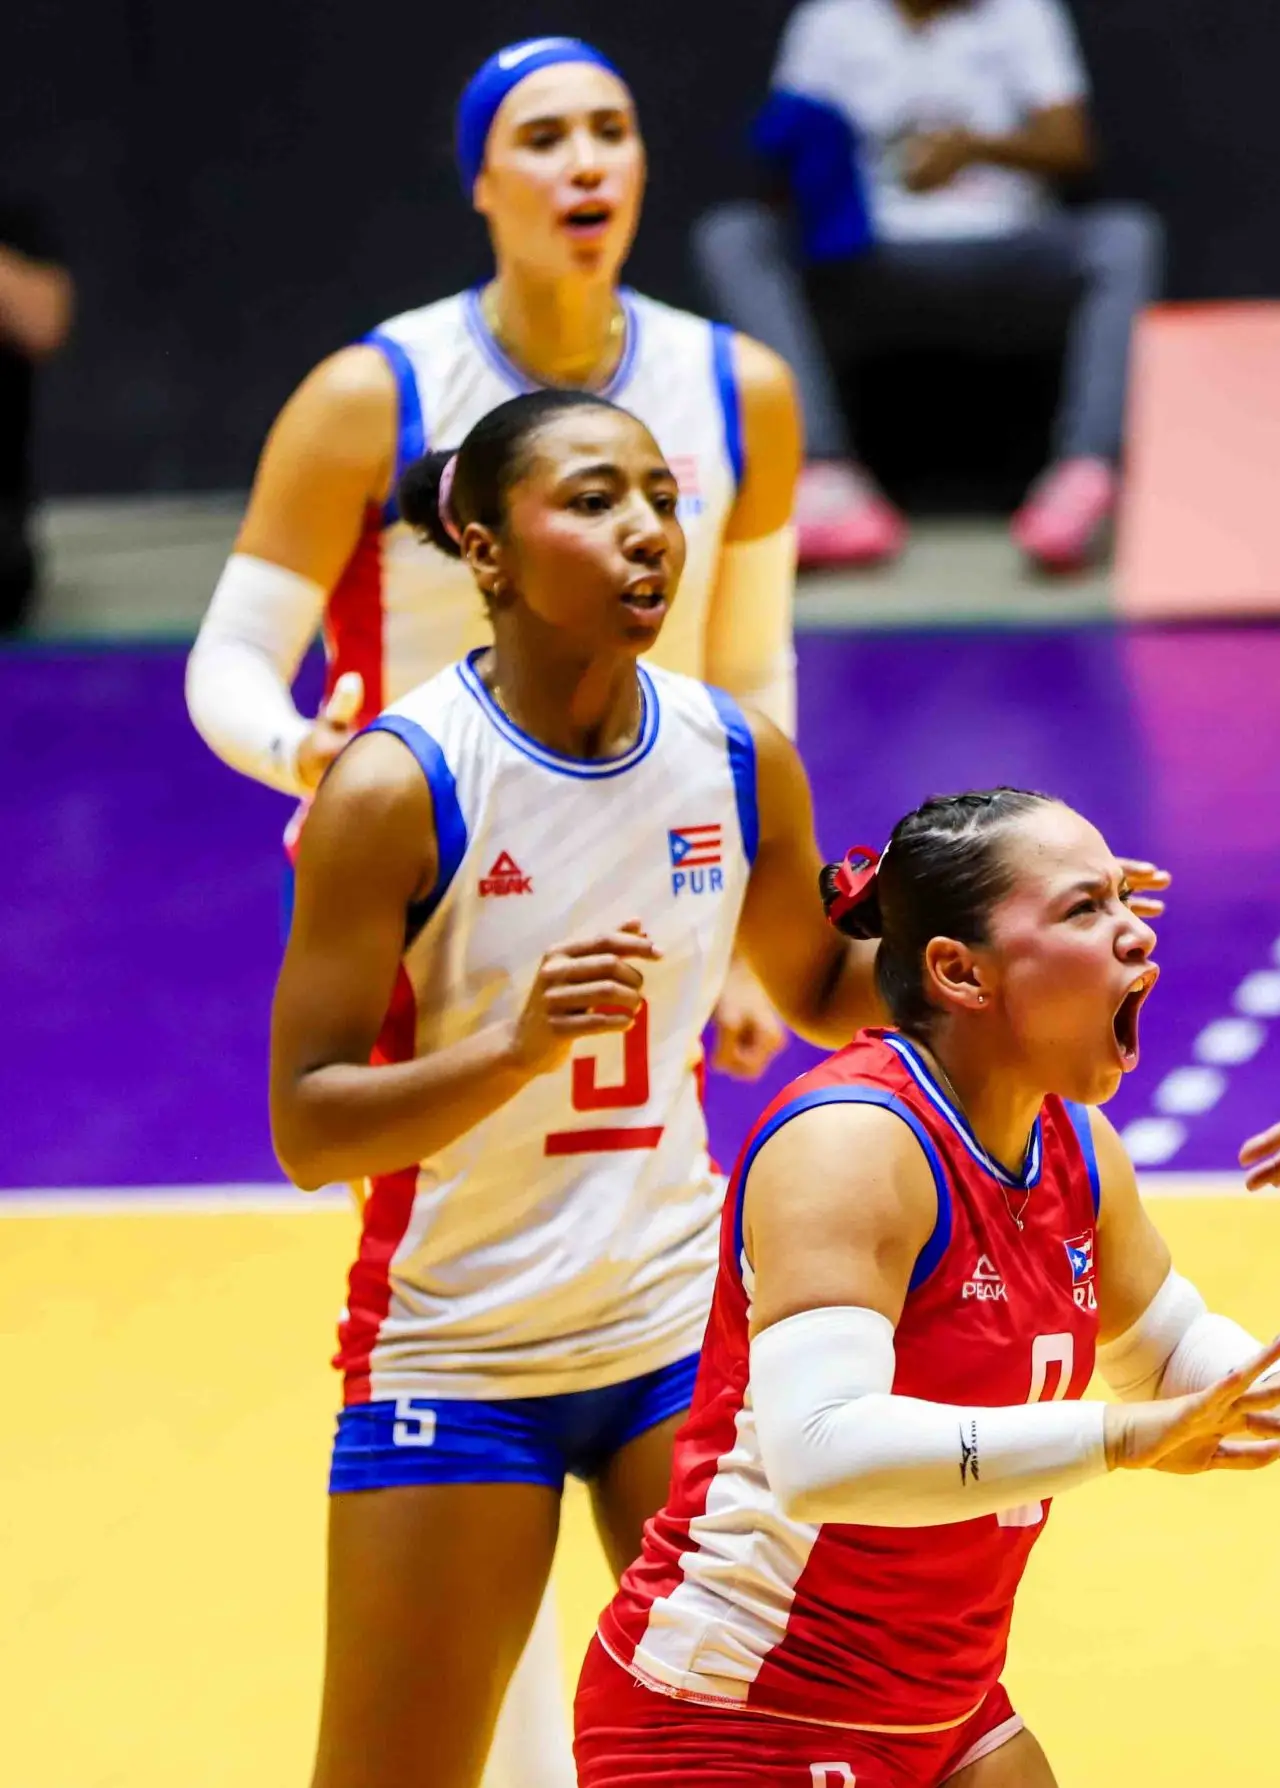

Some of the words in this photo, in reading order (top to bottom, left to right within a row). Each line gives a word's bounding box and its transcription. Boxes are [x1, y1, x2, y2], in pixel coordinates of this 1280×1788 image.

[671, 867, 724, 898] PUR
[962, 1281, 1009, 1302] PEAK
[392, 1395, 437, 1447] 5
